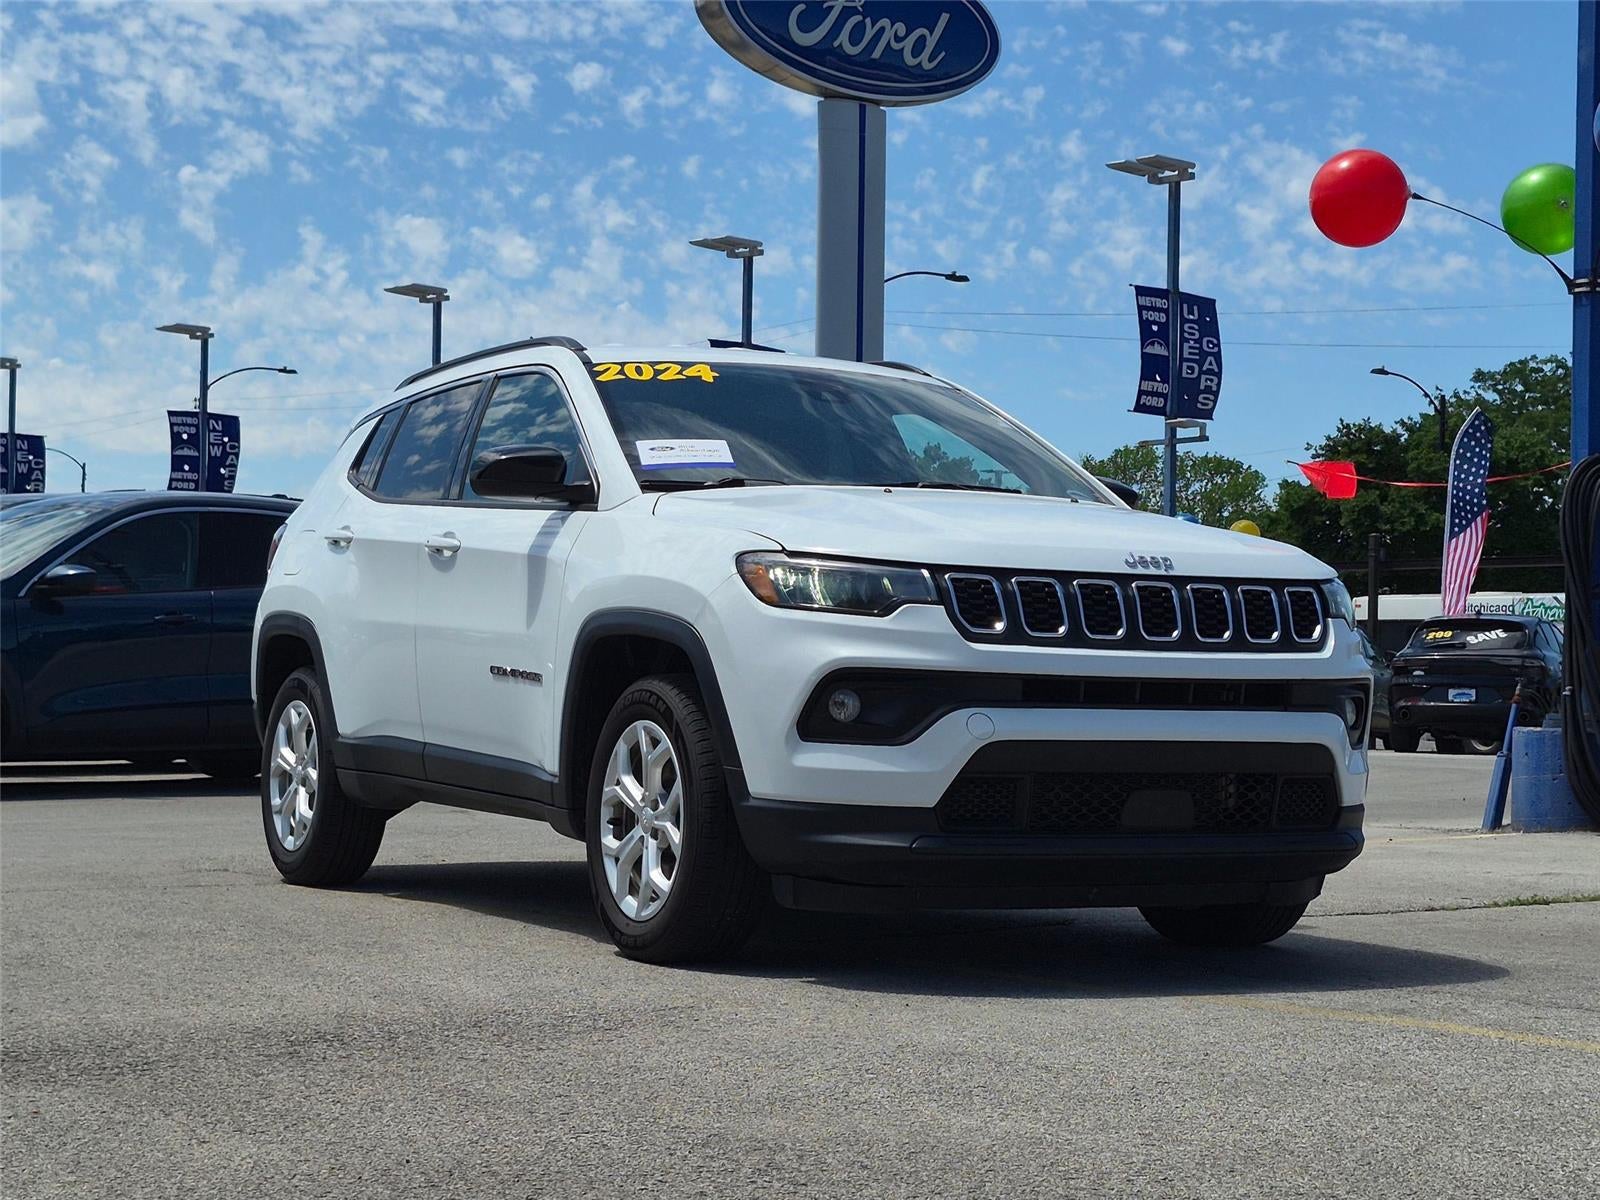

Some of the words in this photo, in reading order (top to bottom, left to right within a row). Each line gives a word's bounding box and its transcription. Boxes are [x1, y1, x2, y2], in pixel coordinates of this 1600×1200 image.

[787, 0, 950, 70] Ford
[1137, 295, 1168, 309] METRO
[1142, 310, 1167, 323] FORD
[1182, 303, 1199, 378] USED
[592, 362, 720, 383] 2024
[1197, 337, 1218, 409] CARS
[1140, 380, 1169, 394] METRO
[1139, 395, 1165, 408] FORD
[169, 415, 199, 425] METRO
[173, 425, 197, 434] FORD
[209, 418, 223, 457] NEW
[16, 439, 29, 474] NEW
[31, 458, 44, 492] CAR
[170, 471, 199, 480] METRO
[171, 481, 196, 490] FORD
[1124, 551, 1175, 573] Jeep
[1466, 602, 1513, 614] itchicago
[1466, 628, 1507, 643] SAVE
